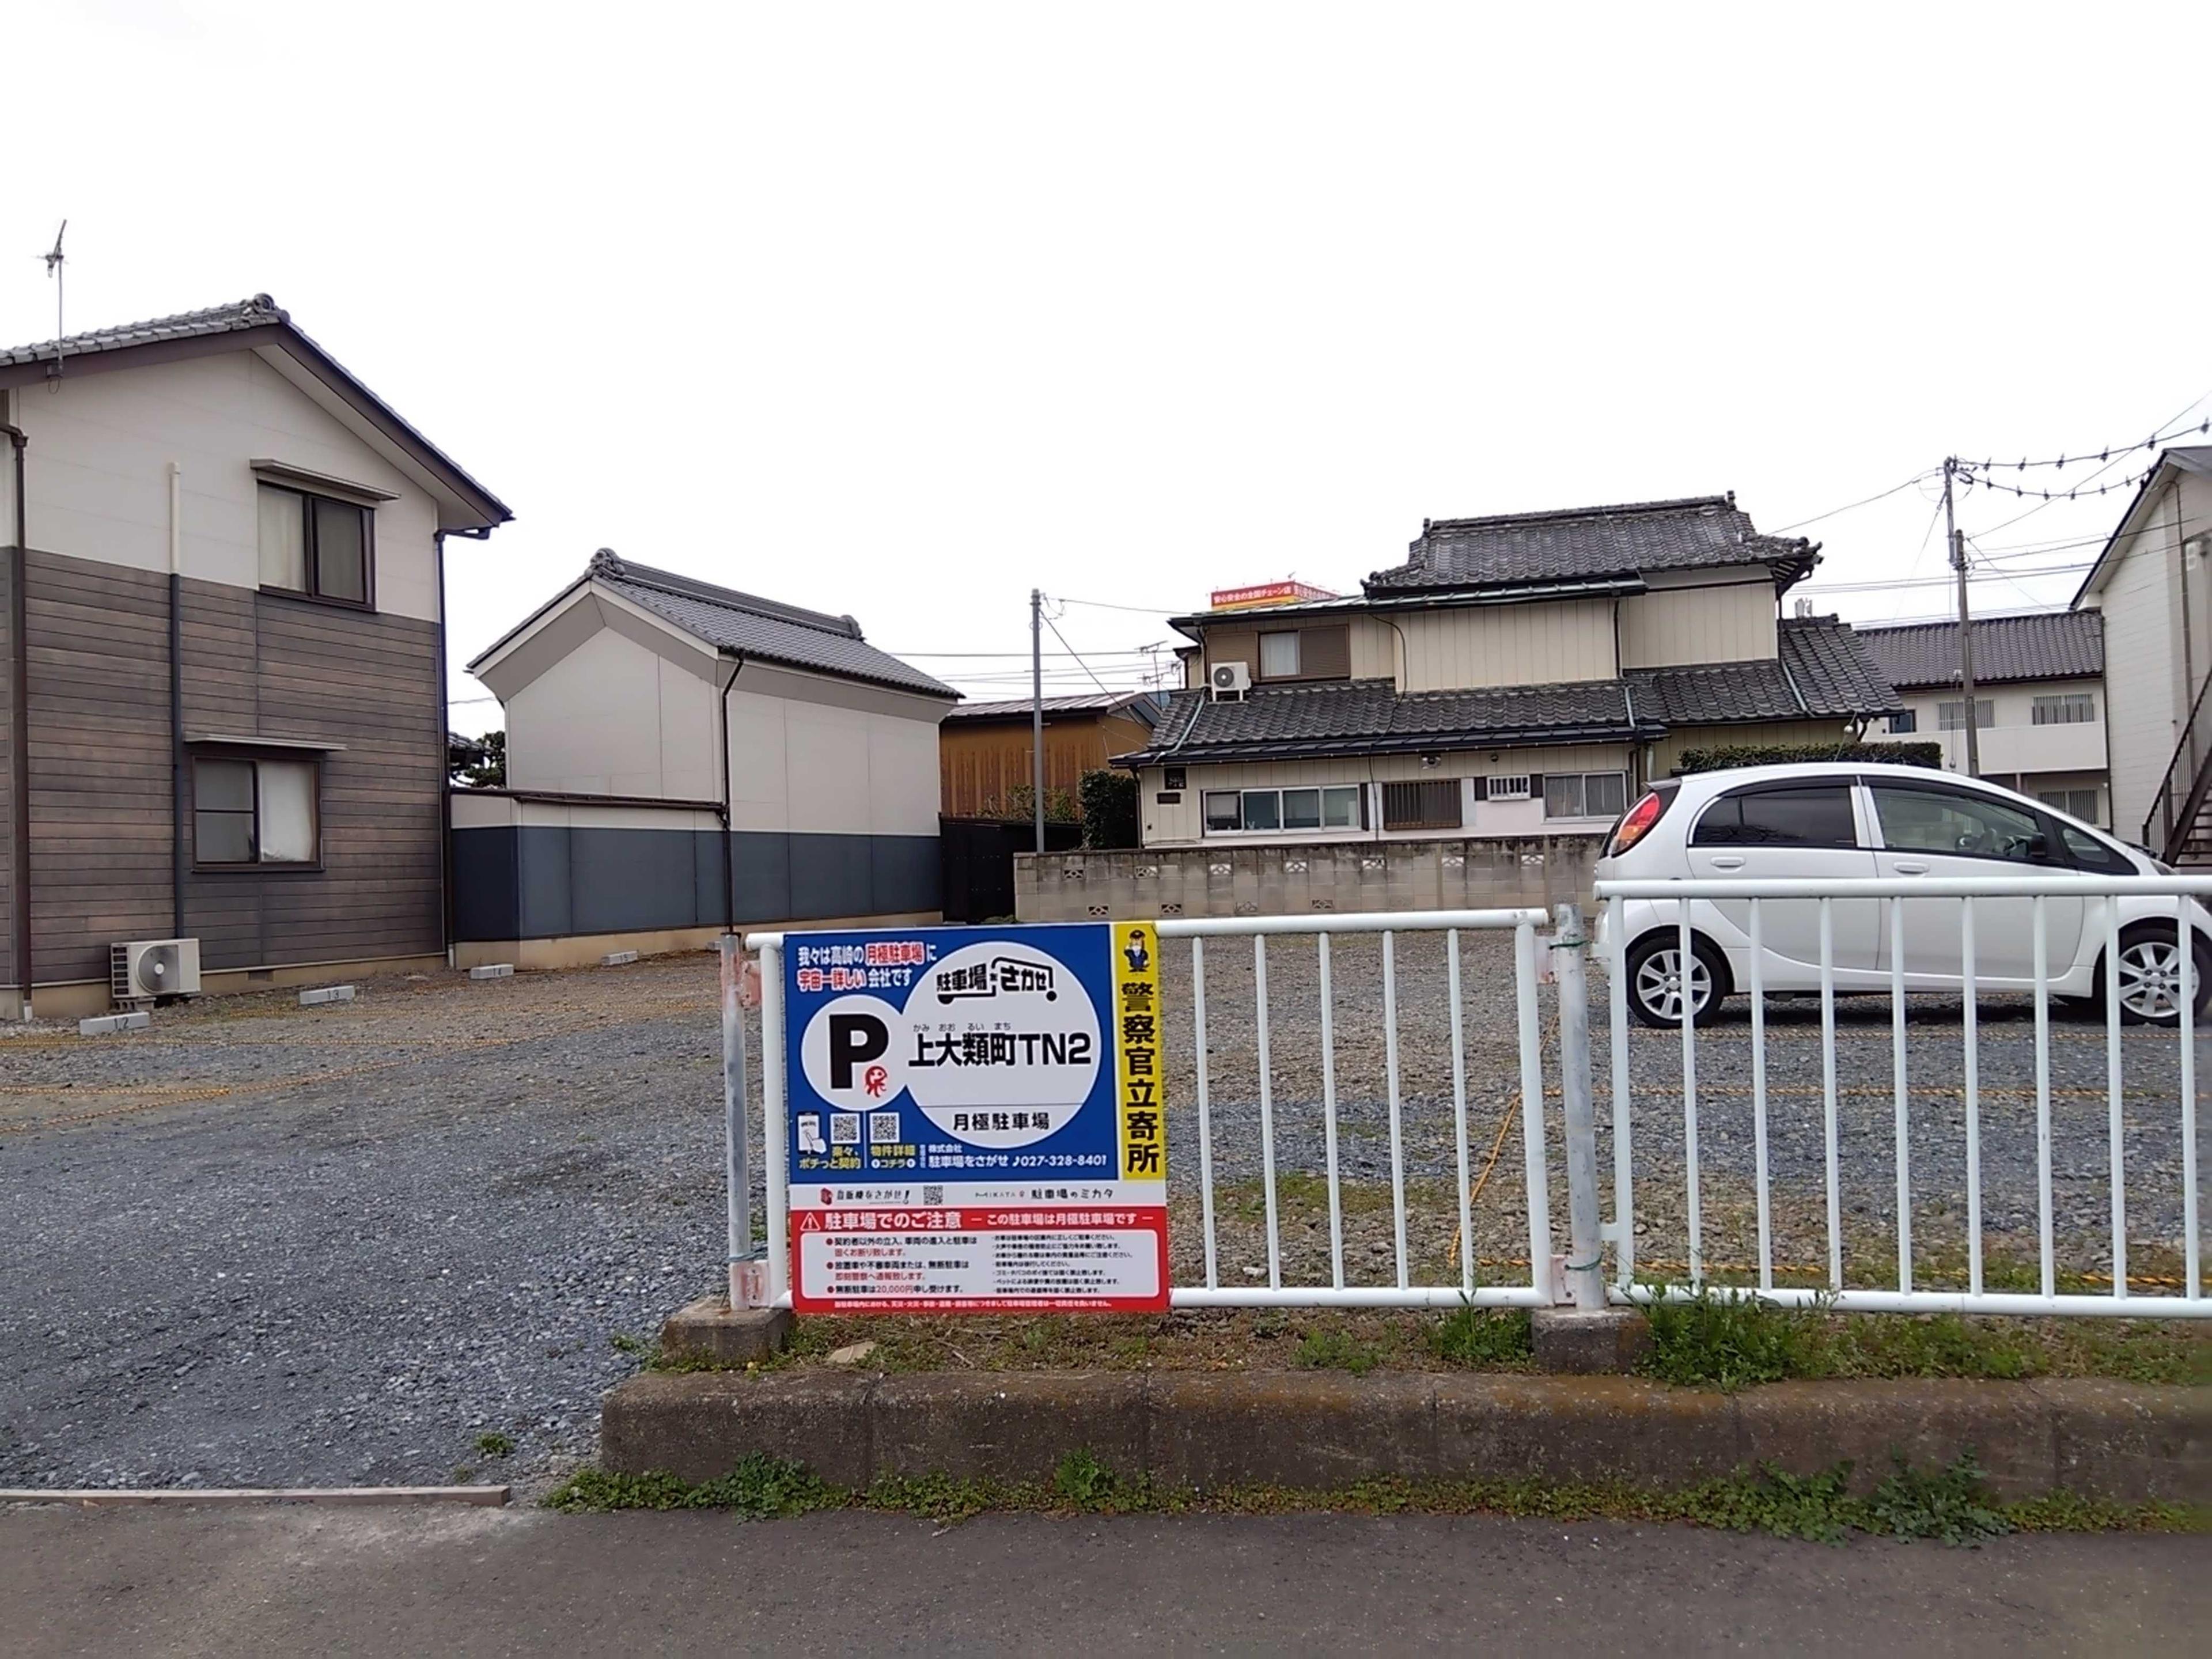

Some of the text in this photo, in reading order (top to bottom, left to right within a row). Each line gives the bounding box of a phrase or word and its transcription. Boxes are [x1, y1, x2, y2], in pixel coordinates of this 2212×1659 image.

[327, 990, 339, 999] 13
[114, 1017, 129, 1029] 12
[913, 1022, 1011, 1032] かみ おお るい まち
[830, 1014, 889, 1089] P
[908, 1032, 1091, 1067] 上大類町TN2
[1122, 982, 1159, 1173] 警察官立寄所
[953, 1112, 1050, 1131] 月極駐車場
[871, 1145, 915, 1156] 物件詳細
[928, 1144, 963, 1153] 株式会社
[881, 1159, 906, 1168] コチラ
[928, 1155, 1009, 1168] 駐車場をさがせ
[1020, 1154, 1107, 1167] 027-328-8401
[1031, 1188, 1113, 1199] 駐車場のミカタ
[825, 1211, 962, 1230] 駐車場でのご注意
[987, 1212, 1137, 1225] この駐車場は月極駐車場です
